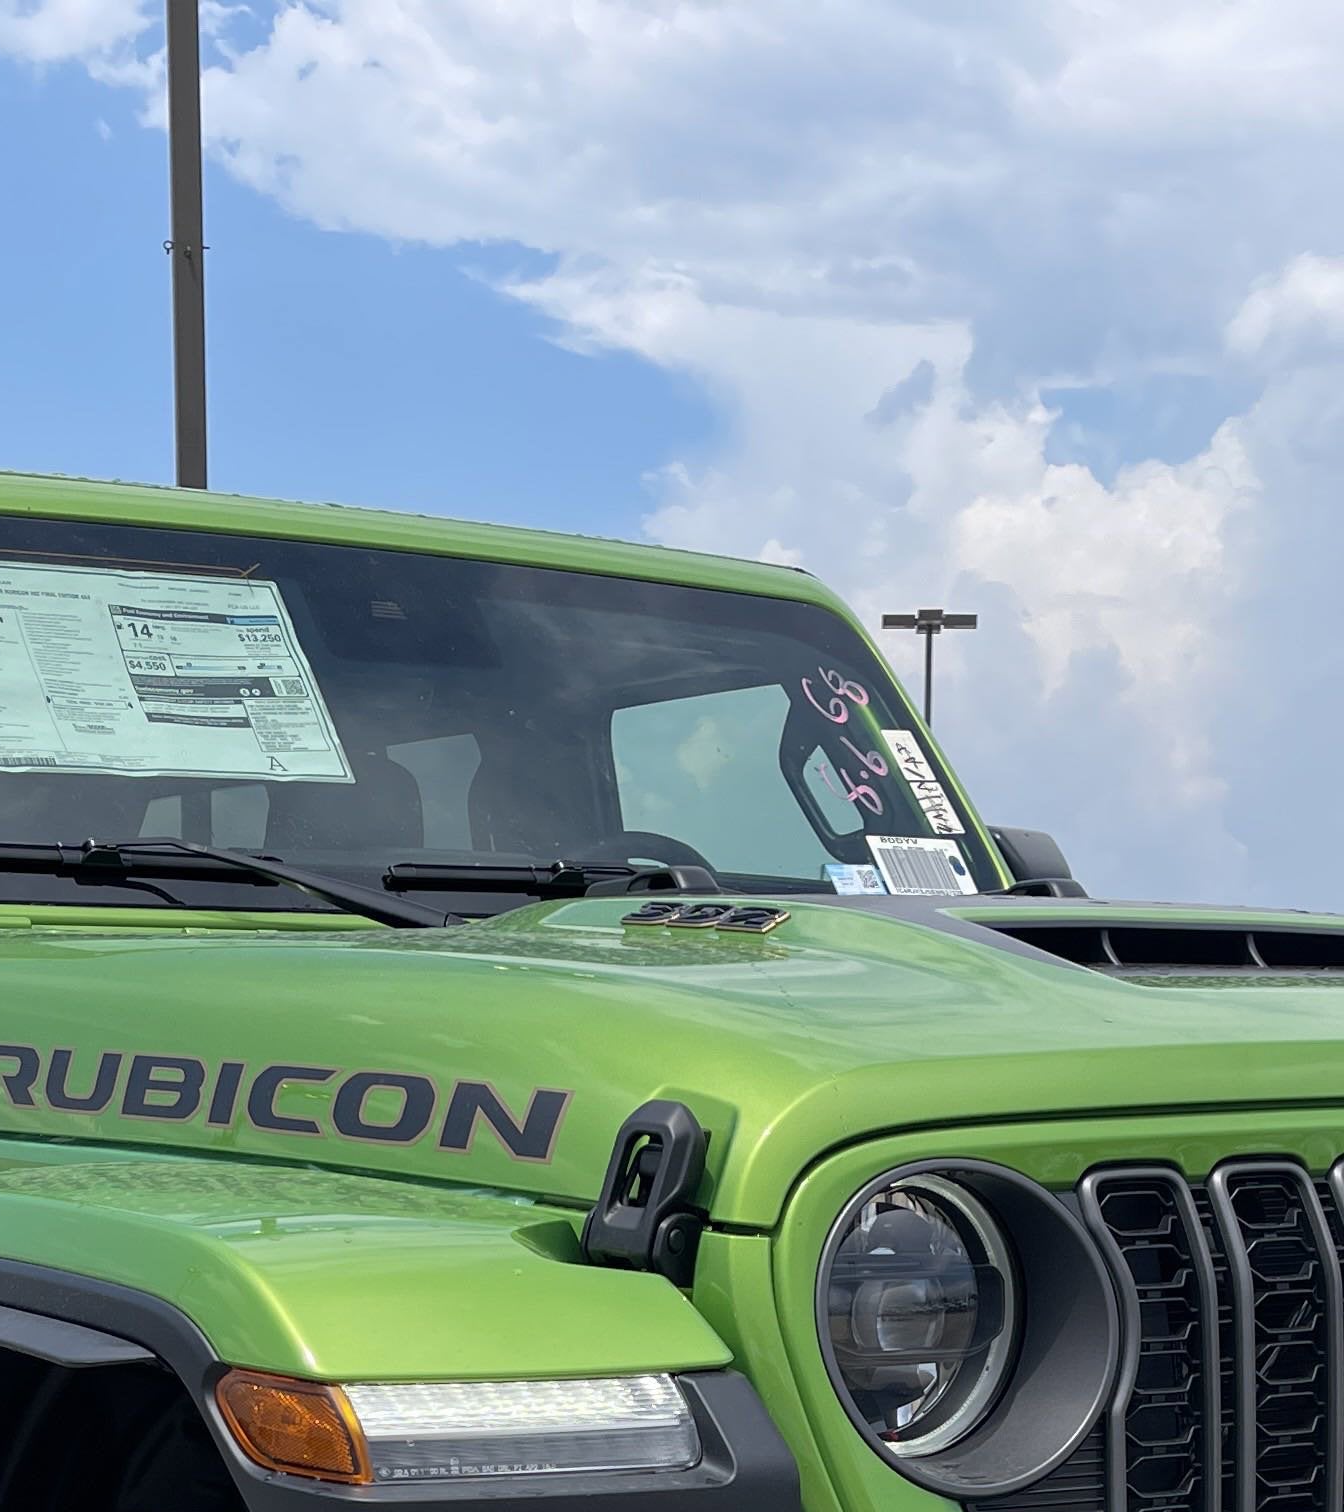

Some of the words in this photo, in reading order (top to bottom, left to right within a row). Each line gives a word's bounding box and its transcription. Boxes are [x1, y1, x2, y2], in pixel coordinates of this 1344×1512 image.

[127, 622, 154, 639] 14
[246, 626, 270, 635] spend
[128, 660, 167, 671] $4,550
[266, 756, 288, 772] A
[620, 901, 792, 934] 392
